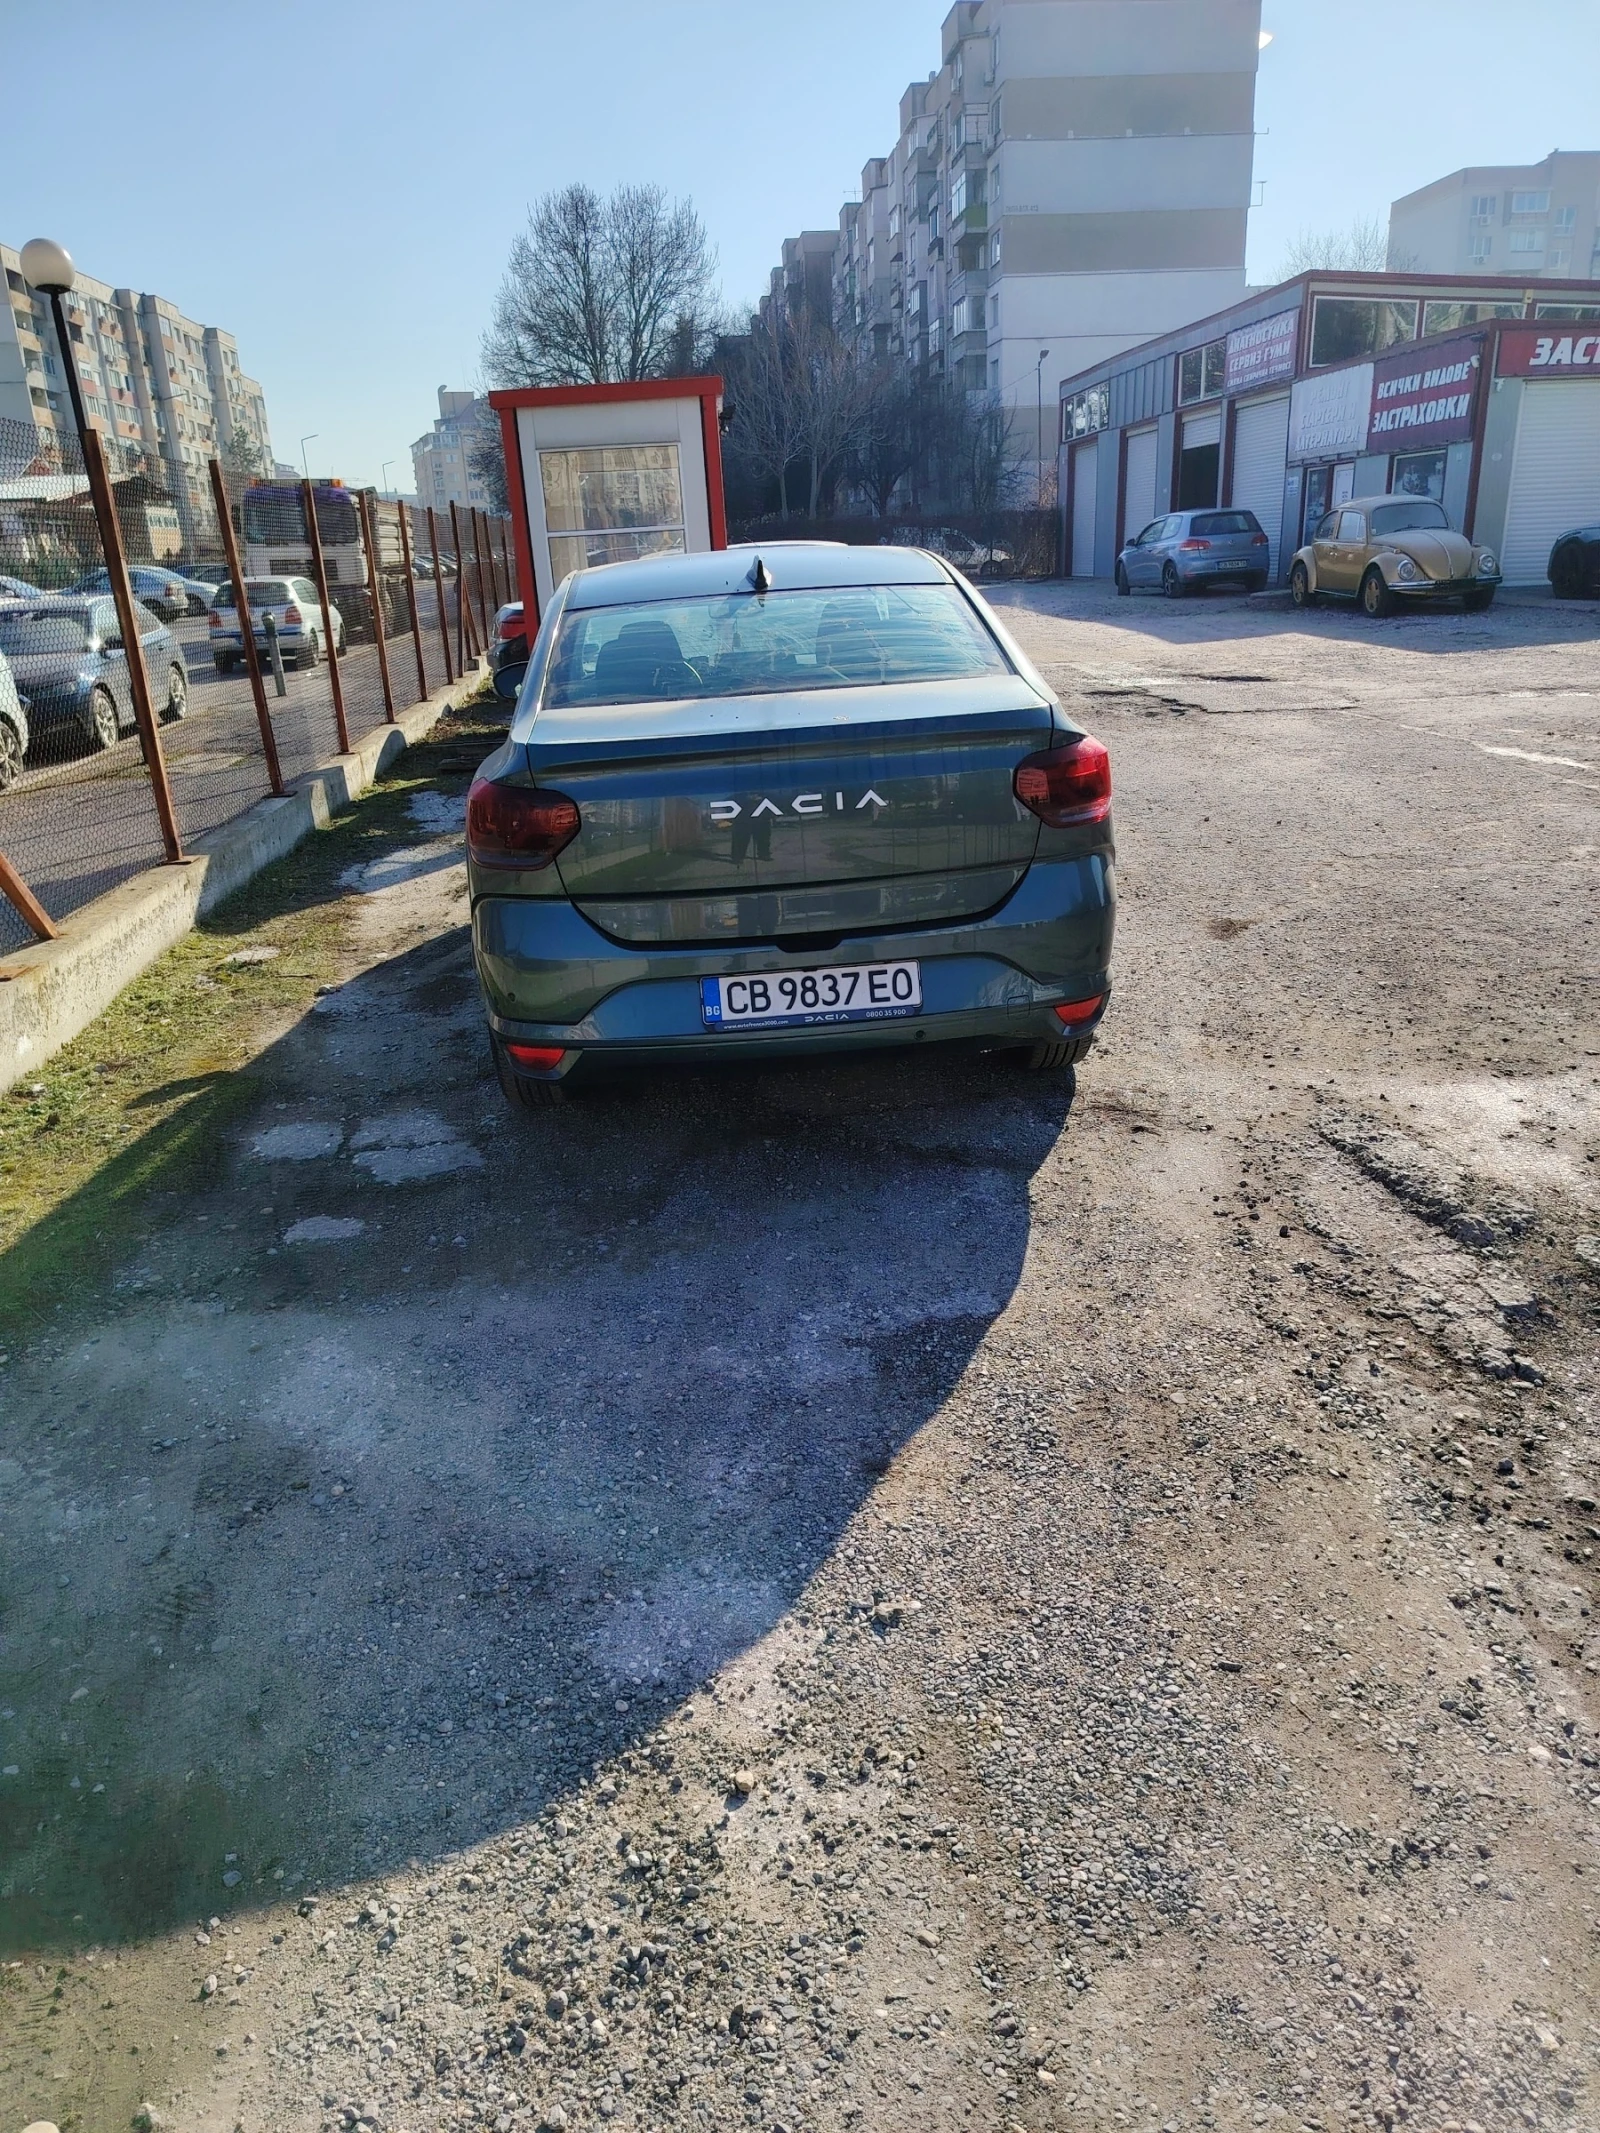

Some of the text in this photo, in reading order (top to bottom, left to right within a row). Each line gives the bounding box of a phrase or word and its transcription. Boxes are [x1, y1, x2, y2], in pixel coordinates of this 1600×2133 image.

[1228, 318, 1294, 354] ДИАГНОСТИКА
[1229, 340, 1291, 373] СЕРВИЗ ГУМИ
[1377, 361, 1471, 400] ВСИЧКИ ВИДОВЕ
[1371, 393, 1471, 433] ЗАСТРАХОВКИ
[709, 788, 889, 820] DACIA
[726, 968, 913, 1014] CB 9837 EO
[705, 1005, 720, 1016] BG
[804, 1013, 849, 1022] DACIA
[865, 1010, 883, 1018] 0800
